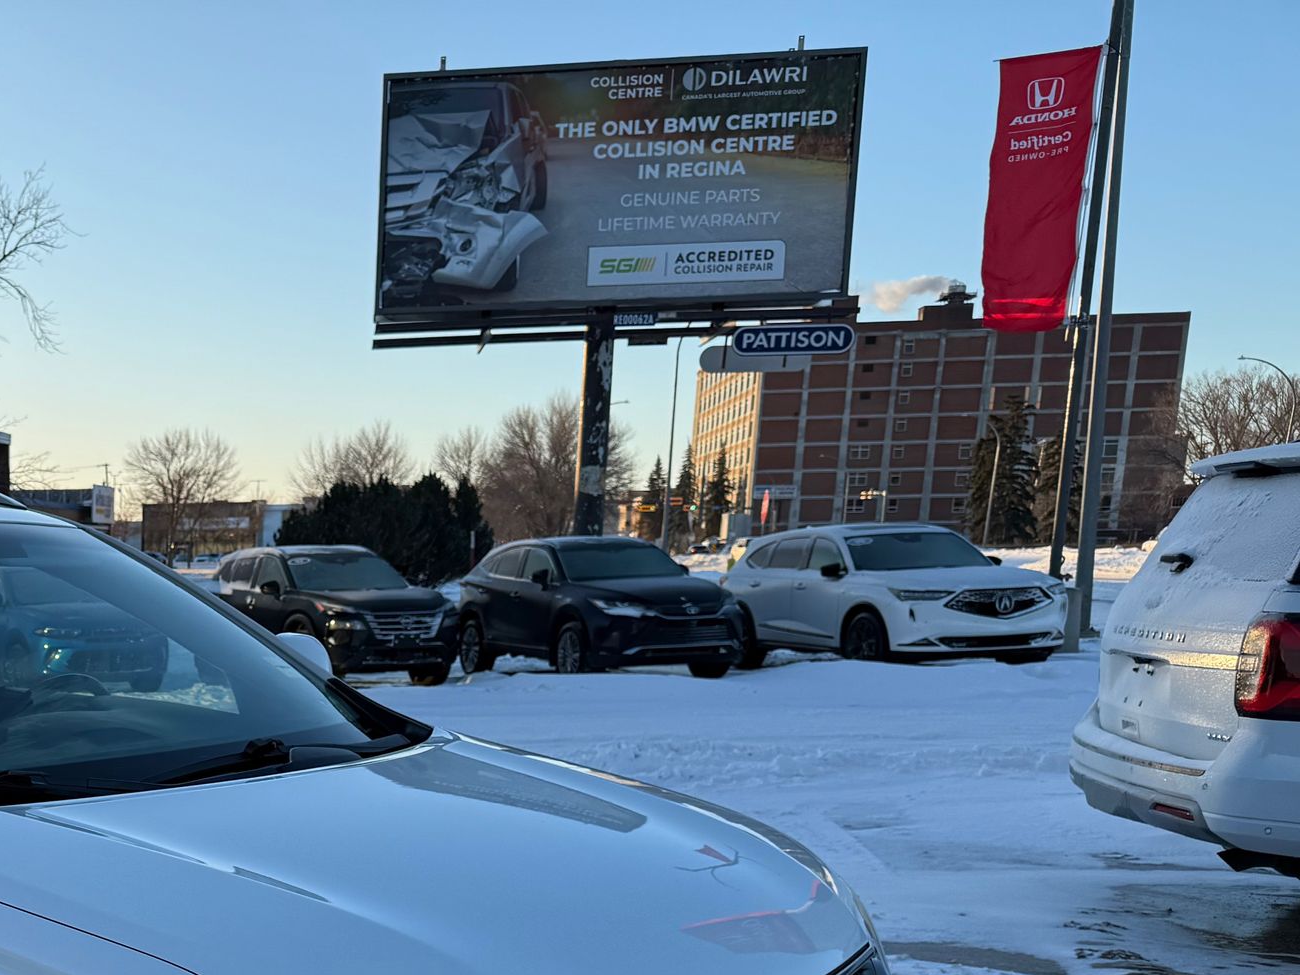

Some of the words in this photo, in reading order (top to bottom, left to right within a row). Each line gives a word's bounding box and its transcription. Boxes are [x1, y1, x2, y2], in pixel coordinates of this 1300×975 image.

[590, 73, 664, 88] COLLISION
[710, 65, 808, 87] DILAWRI
[608, 86, 663, 100] CENTRE
[681, 92, 712, 101] CANADA'S
[713, 91, 741, 99] LARGEST
[742, 90, 781, 98] AUTOMOTIVE
[783, 88, 806, 96] GROUP
[555, 121, 597, 139] THE
[601, 118, 659, 138] ONLY
[663, 115, 722, 134] BMW
[725, 109, 838, 132] CERTIFIED
[592, 139, 705, 160] COLLISION
[710, 134, 796, 155] CENTRE
[637, 163, 660, 180] IN
[666, 159, 746, 179] REGINA
[620, 190, 701, 208] GENUINE
[705, 188, 761, 205] PARTS
[598, 215, 676, 232] LIFETIME
[680, 210, 782, 229] WARRANTY
[599, 257, 642, 274] SGI
[674, 248, 775, 265] ACCREDITED
[674, 264, 733, 275] COLLISION
[735, 262, 774, 272] REPAIR
[741, 330, 846, 349] PATTISON
